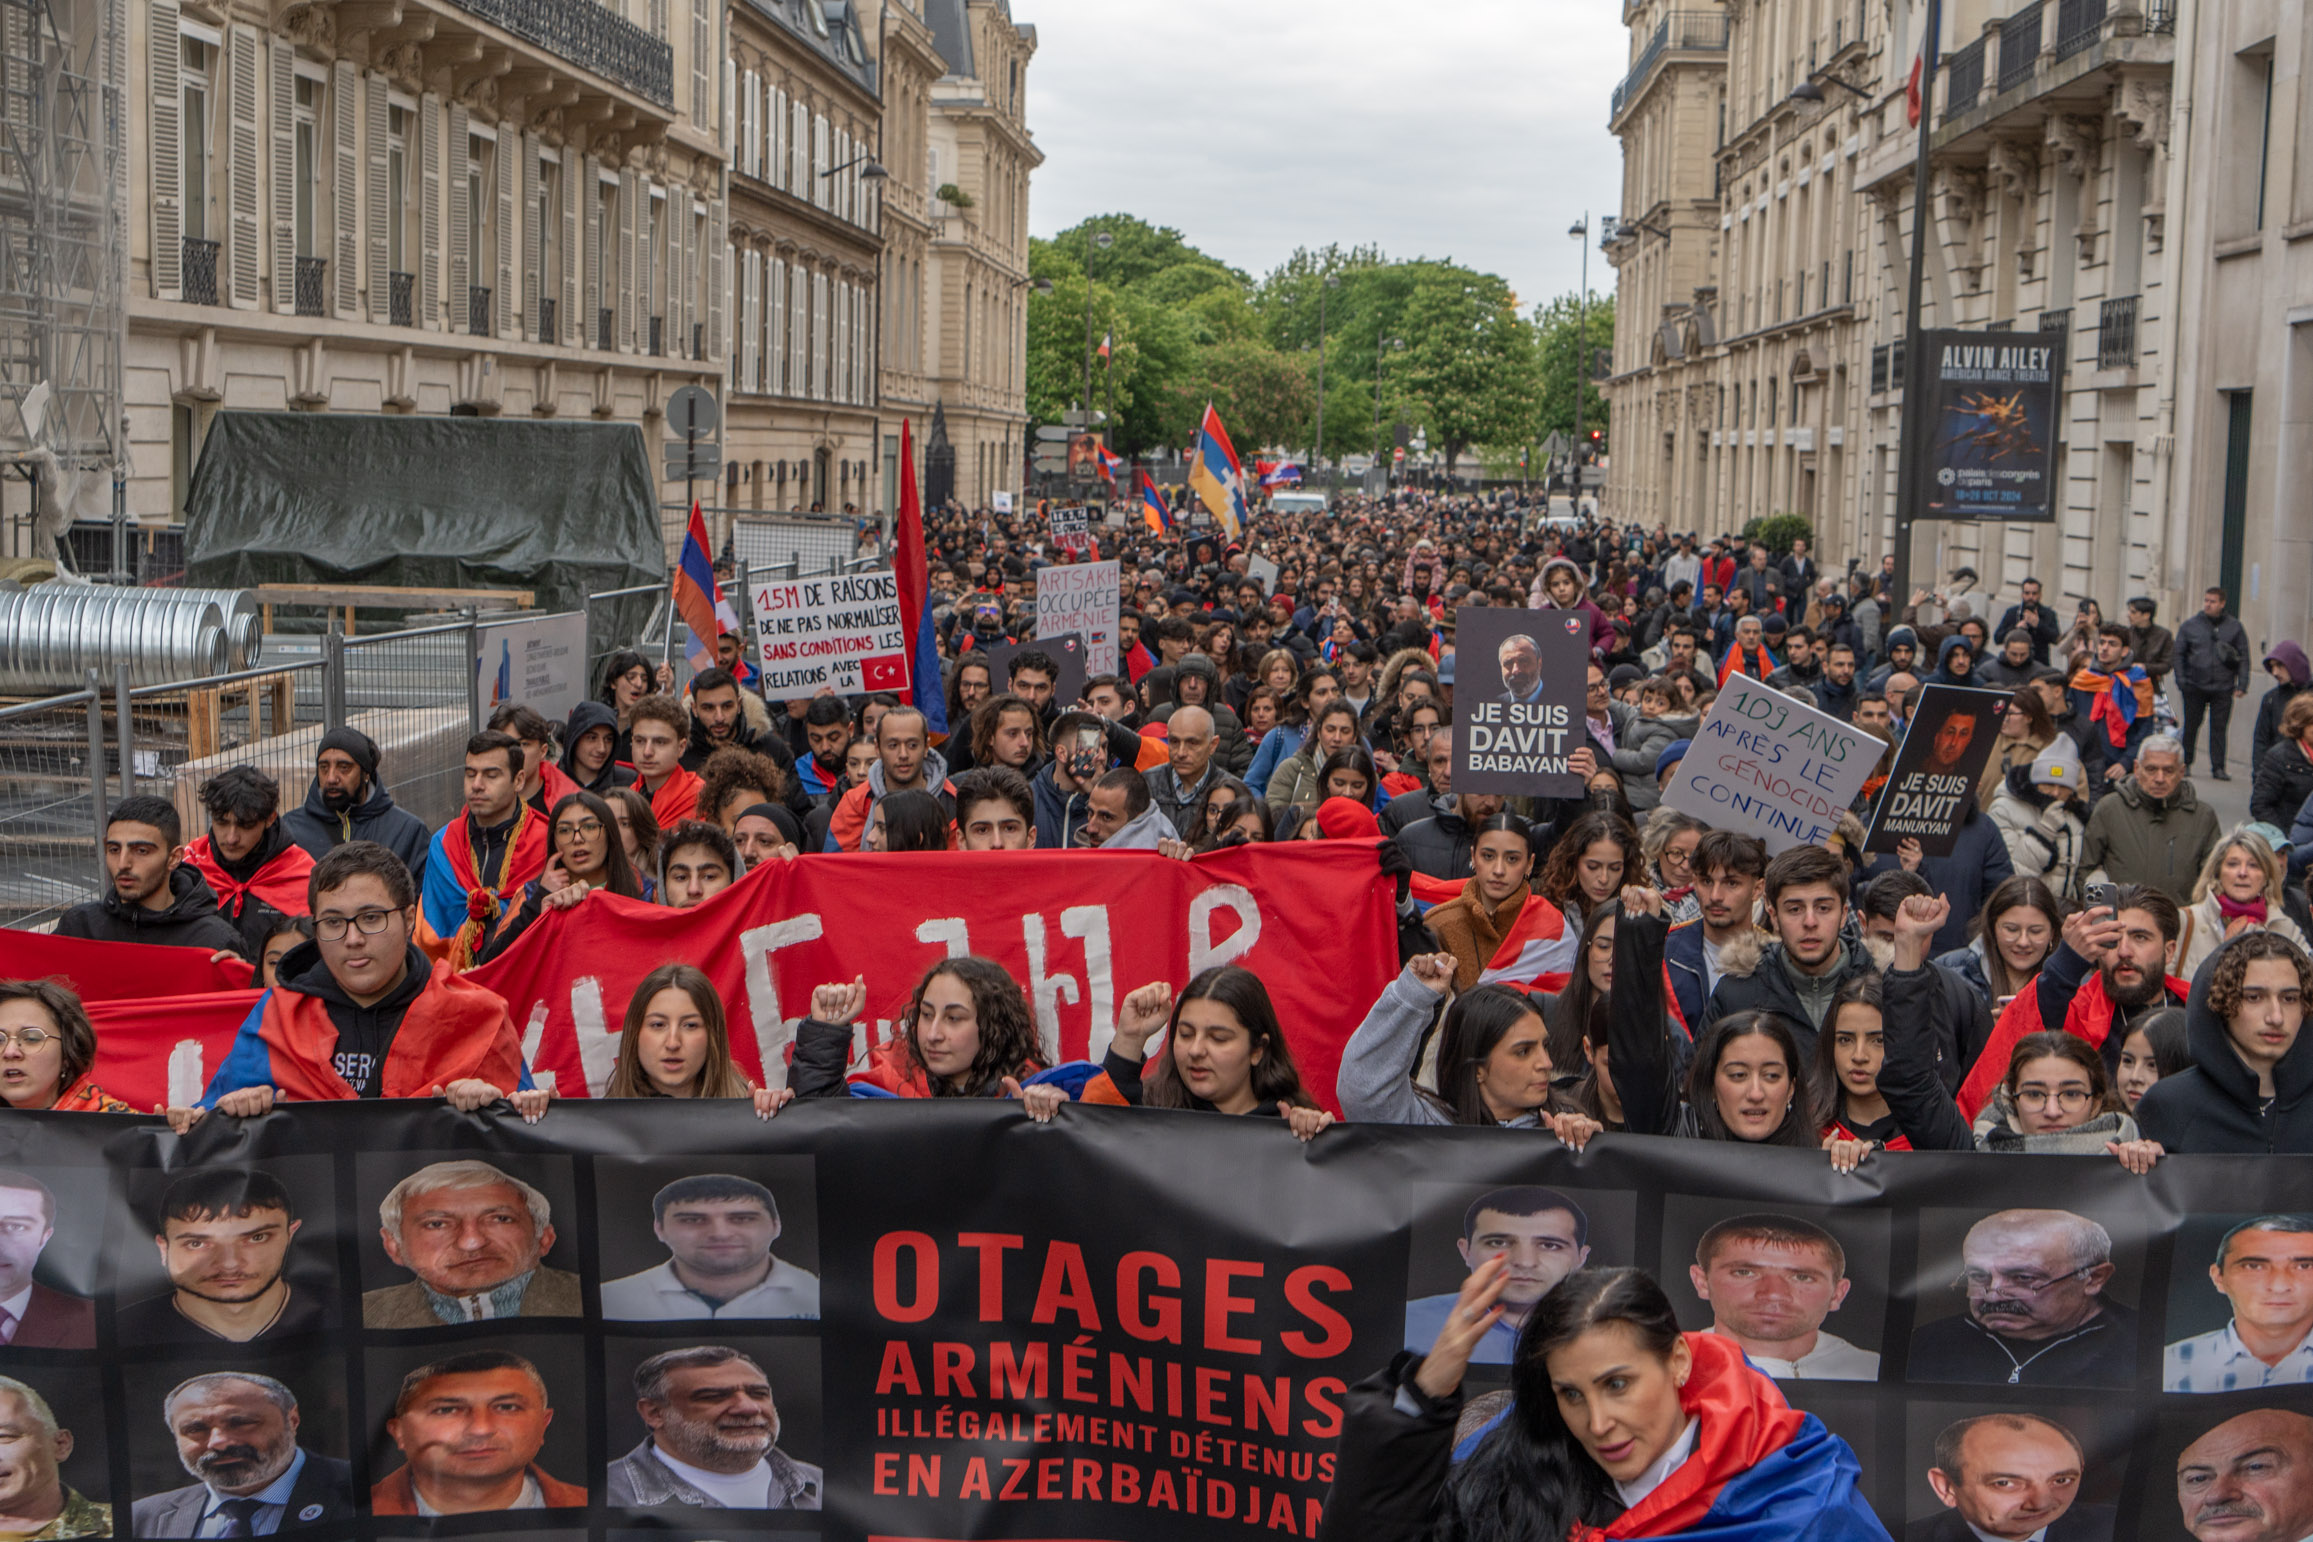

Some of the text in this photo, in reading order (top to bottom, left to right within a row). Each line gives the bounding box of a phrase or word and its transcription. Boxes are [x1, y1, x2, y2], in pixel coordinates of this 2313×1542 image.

[1941, 345, 2050, 369] ALVIN AILEY
[1940, 368, 2050, 382] AMERICAN DANCE THEATER
[804, 584, 825, 607] DE
[831, 576, 897, 604] RAISONS
[1038, 567, 1117, 592] ARTSAKH
[1039, 588, 1117, 614] OCCUPÉE
[760, 605, 901, 635] DE NE PAS NORMALISER
[1038, 609, 1113, 633] ARMÉNIE
[763, 631, 904, 661] SANS CONDITIONS LES
[765, 660, 860, 690] RELATIONS AVEC
[840, 676, 855, 688] LA
[1471, 702, 1569, 726] JE SUIS
[1729, 692, 1856, 762] 109 ANS
[1469, 725, 1568, 755] DAVIT
[1469, 754, 1567, 774] BABAYAN
[1706, 719, 1840, 793] APRÈS LE
[1718, 754, 1848, 824] GÉNOCIDE
[1900, 772, 1968, 795] JE SUIS
[1889, 793, 1961, 820] DAVIT
[1883, 818, 1951, 835] MANUKYAN
[335, 1052, 376, 1078] SER
[873, 1230, 1353, 1359] OTAGES
[875, 1335, 1348, 1438] ARMÉNIENS
[877, 1405, 1337, 1483] ILLÉGALEMENT DÉTENUS
[873, 1453, 1326, 1539] EN AZERBAÏDJAN
